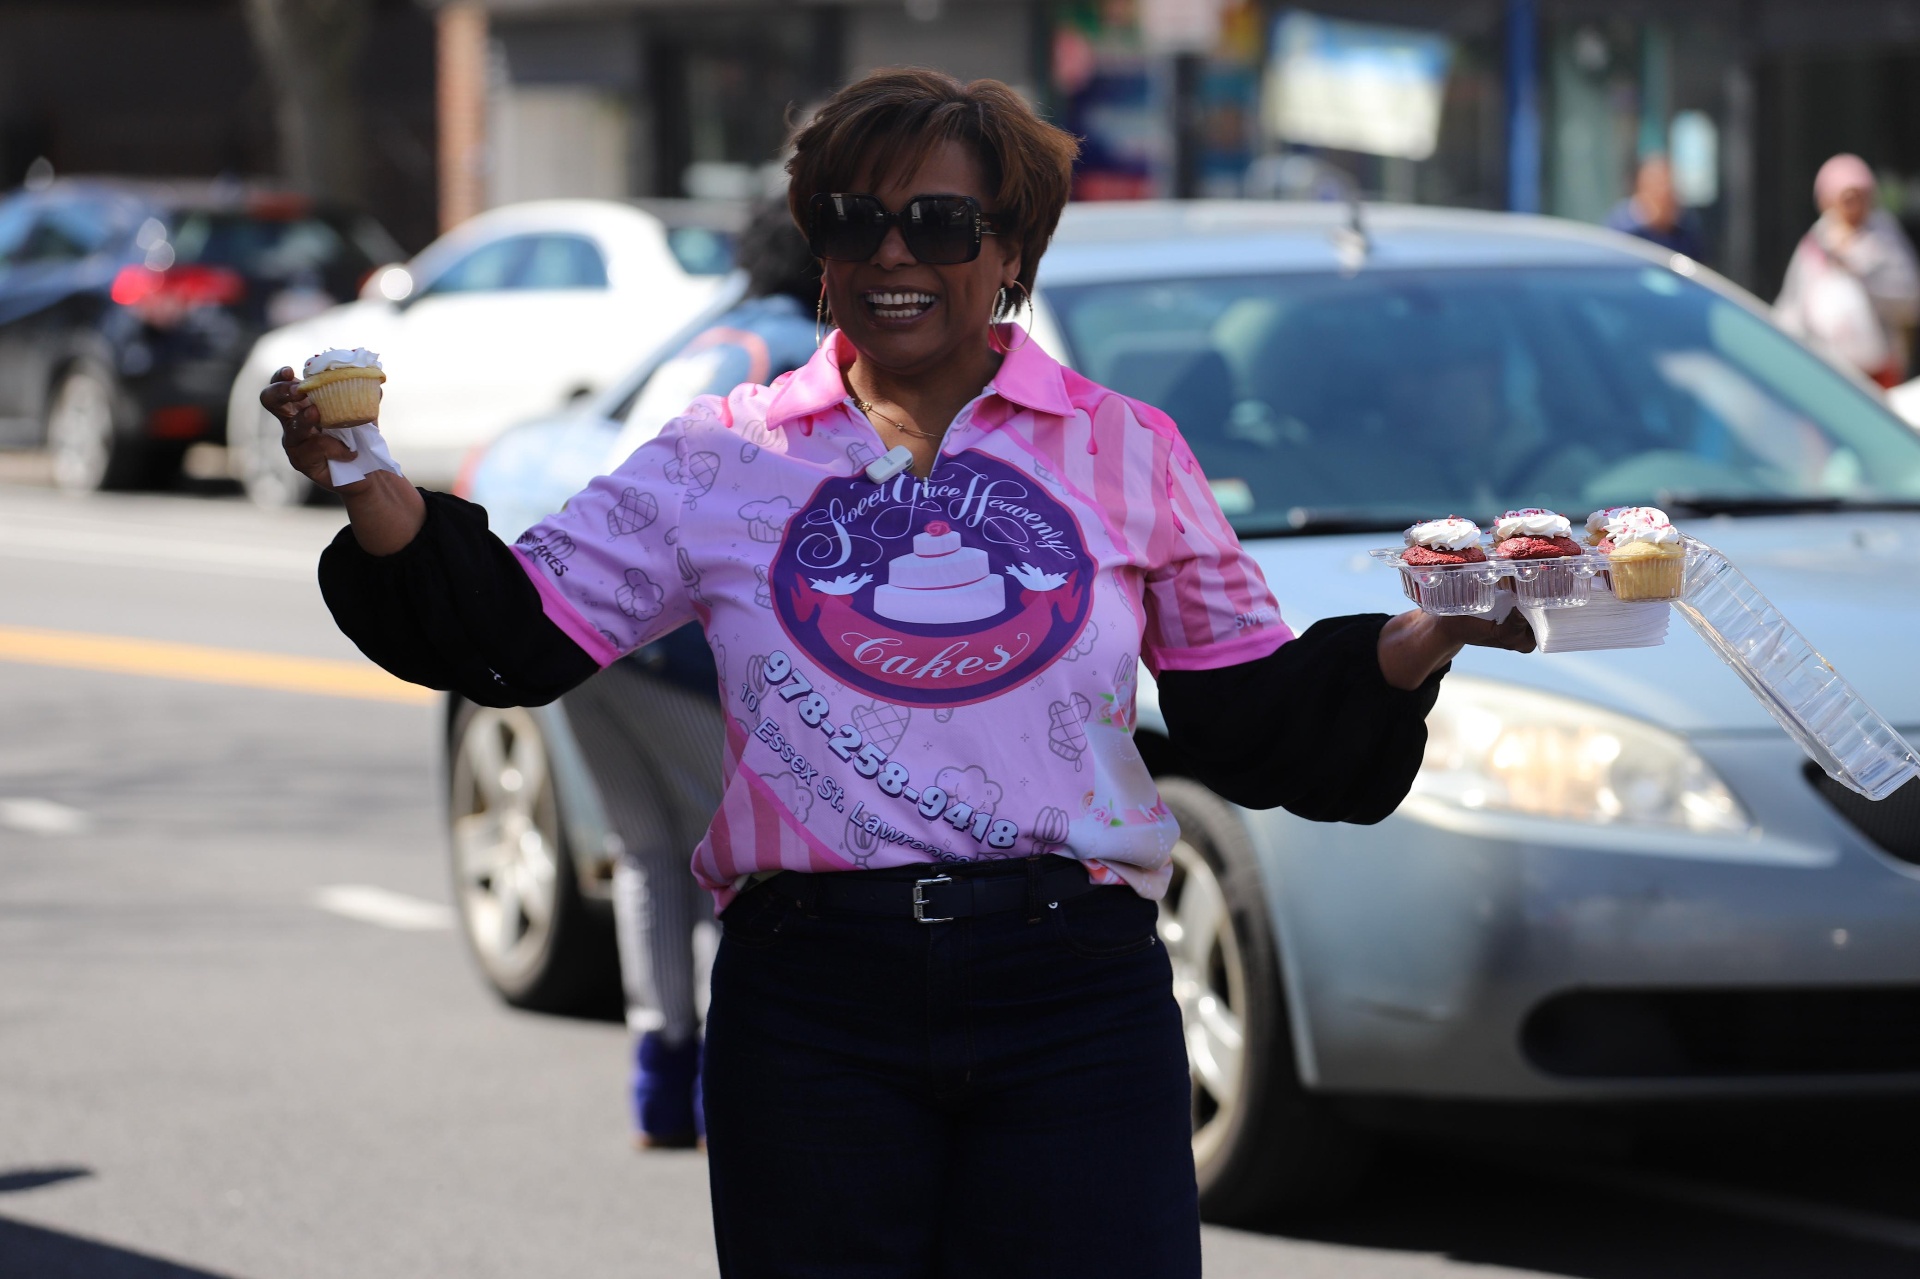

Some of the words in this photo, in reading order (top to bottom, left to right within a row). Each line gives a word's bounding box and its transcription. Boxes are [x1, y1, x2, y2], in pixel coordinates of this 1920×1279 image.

[796, 480, 890, 568] Sweet
[946, 462, 1076, 560] Heavenly
[841, 632, 1030, 679] Cakes
[754, 716, 818, 786] Essex
[816, 774, 846, 813] St.
[762, 649, 1019, 849] 978-258-9418
